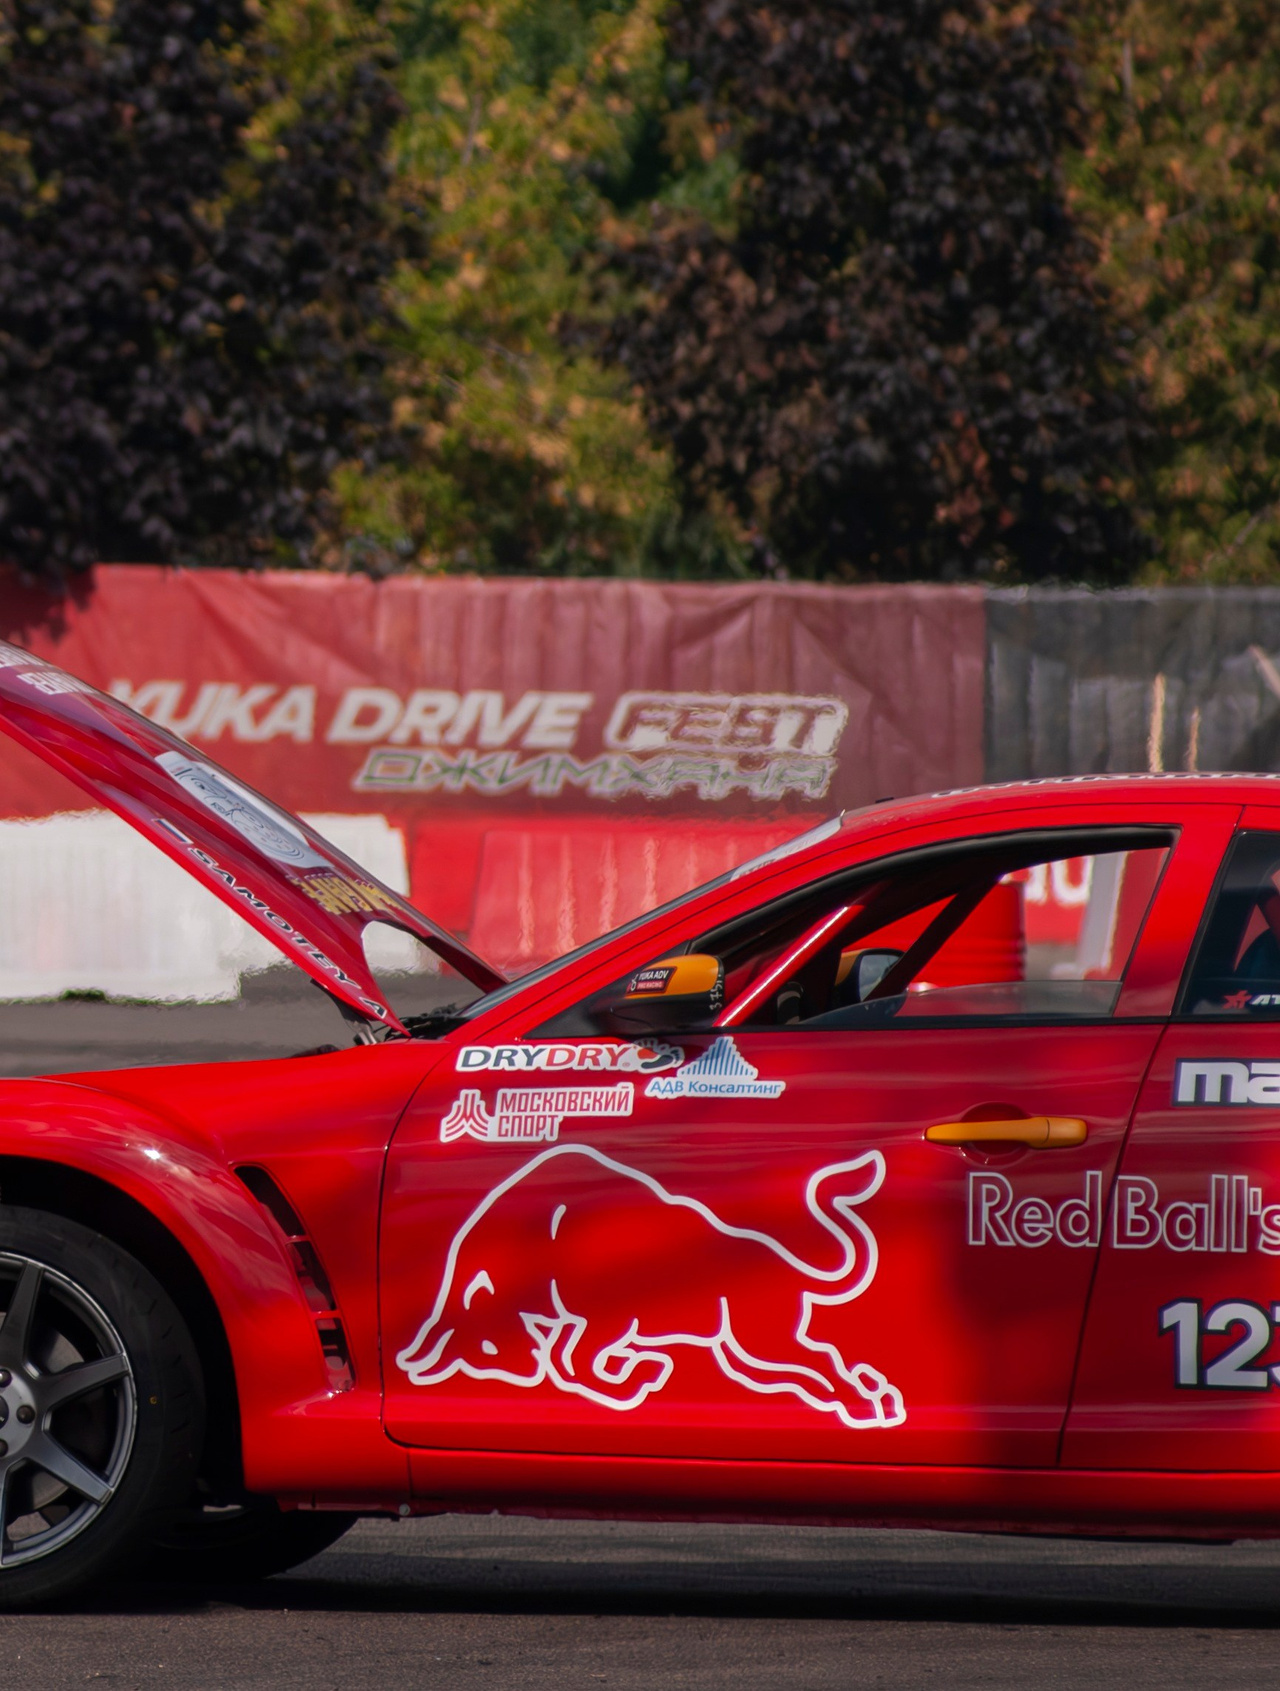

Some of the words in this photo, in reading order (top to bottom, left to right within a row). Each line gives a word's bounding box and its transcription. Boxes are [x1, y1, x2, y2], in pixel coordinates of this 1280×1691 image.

[108, 680, 317, 741] YUKA
[326, 687, 593, 748] DRIVE
[620, 698, 840, 752] FEST
[353, 749, 838, 800] ДЖИМХАНА
[188, 847, 362, 990] SAMOTEY
[358, 996, 388, 1019] A
[460, 1047, 628, 1068] DRYDRY
[499, 1086, 630, 1114] МОСКОВСКИЙ
[650, 1081, 684, 1095] АДВ
[688, 1081, 782, 1095] Консалтинг
[497, 1116, 560, 1138] СПОРТ
[968, 1170, 1104, 1248] Red
[1113, 1173, 1280, 1256] Ball's
[1161, 1300, 1280, 1388] 12
